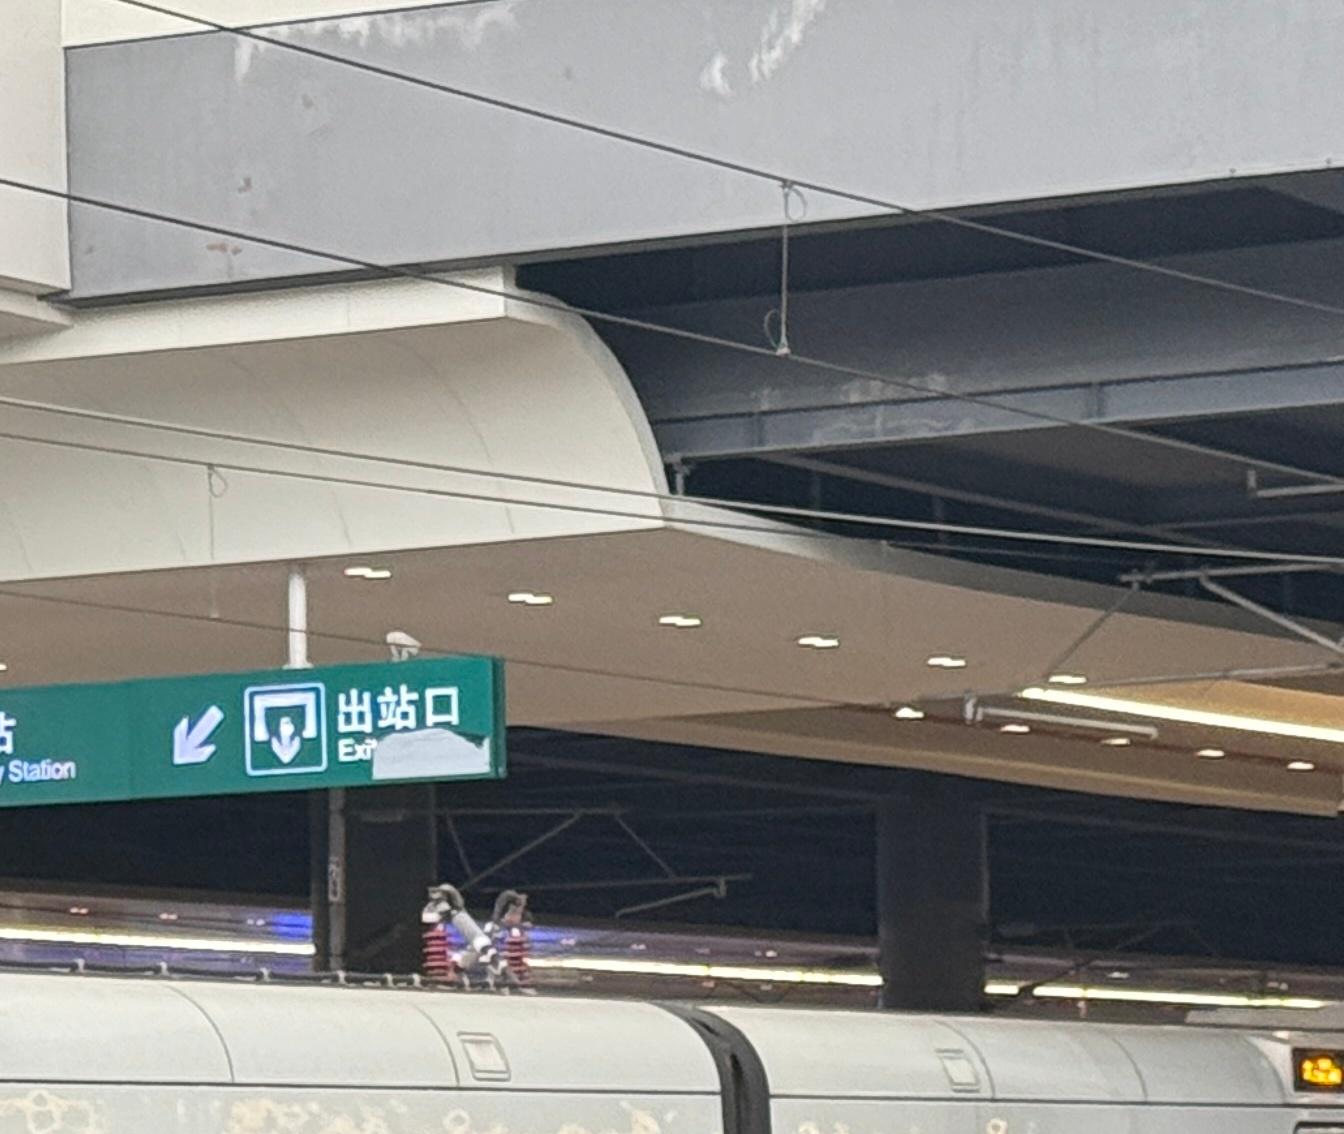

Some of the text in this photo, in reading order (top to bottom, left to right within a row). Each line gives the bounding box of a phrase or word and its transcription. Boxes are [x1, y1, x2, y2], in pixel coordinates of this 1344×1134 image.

[338, 683, 459, 734] 出站口
[8, 758, 77, 783] Station
